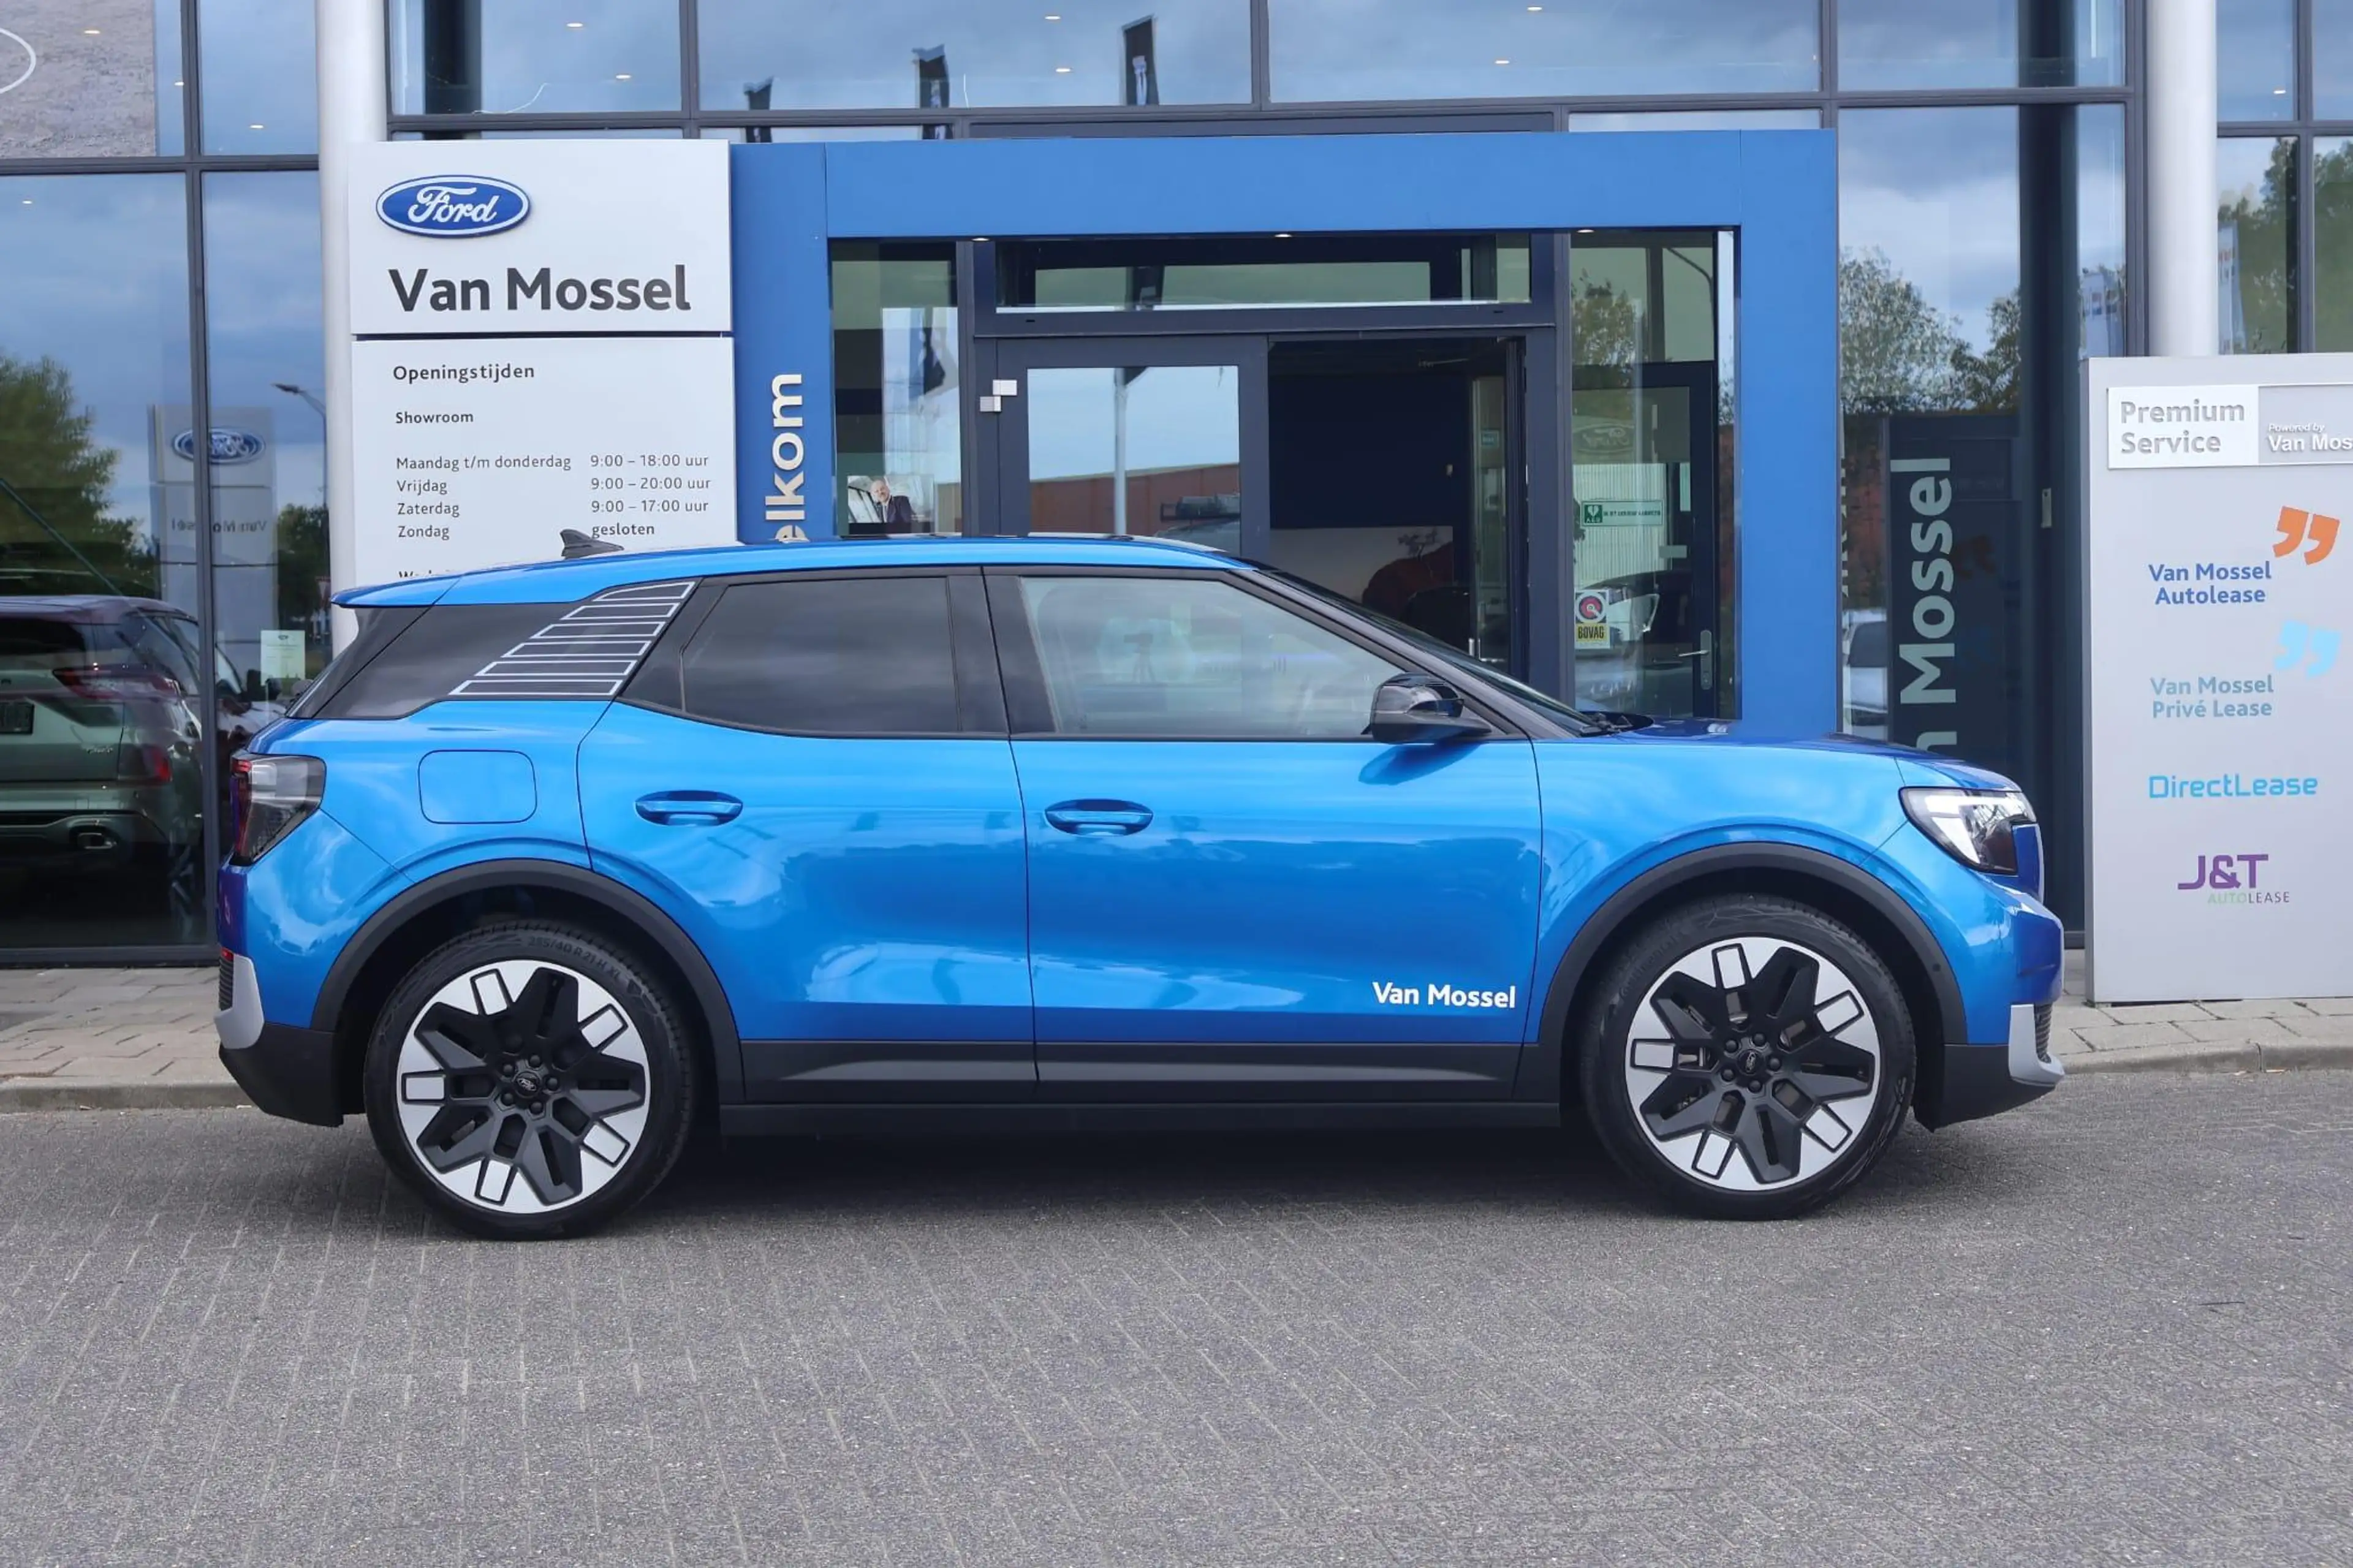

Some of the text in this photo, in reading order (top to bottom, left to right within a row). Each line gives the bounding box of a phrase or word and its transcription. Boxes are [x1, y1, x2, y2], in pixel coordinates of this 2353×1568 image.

[407, 184, 500, 223] Ford
[388, 264, 691, 312] Van Mossel
[393, 363, 535, 384] Openingstijden
[395, 411, 474, 424] Showroom
[2120, 399, 2245, 423] Premium
[2313, 422, 2325, 433] by
[2121, 430, 2222, 454] Service
[2268, 434, 2305, 451] Van
[396, 455, 571, 472] Maandag t/m donderdag
[590, 455, 623, 467] 9:00
[640, 454, 680, 467] 18:00
[685, 456, 709, 466] uur
[396, 479, 447, 495] Vrijdag
[591, 477, 624, 490] 9:00
[640, 477, 682, 490] 20:00
[688, 479, 711, 489] uur
[397, 502, 460, 518] Zaterdag
[591, 500, 624, 512] 9:00
[641, 500, 680, 512] 17:00
[685, 501, 708, 512] uur
[398, 525, 450, 540] Zondag
[591, 523, 655, 538] gesloten
[2148, 561, 2272, 581] Van Mossel
[1890, 458, 1957, 705] Mossel
[2154, 586, 2266, 605] Autolease
[1578, 626, 1605, 639] BOVAG
[2150, 675, 2275, 695] Van Mossel
[2153, 700, 2273, 718] Privé Lease
[2149, 773, 2319, 798] DirectLease
[2178, 854, 2268, 890] J&T
[2207, 892, 2290, 904] AUTOLEASE
[1372, 982, 1515, 1009] Van Mossel
